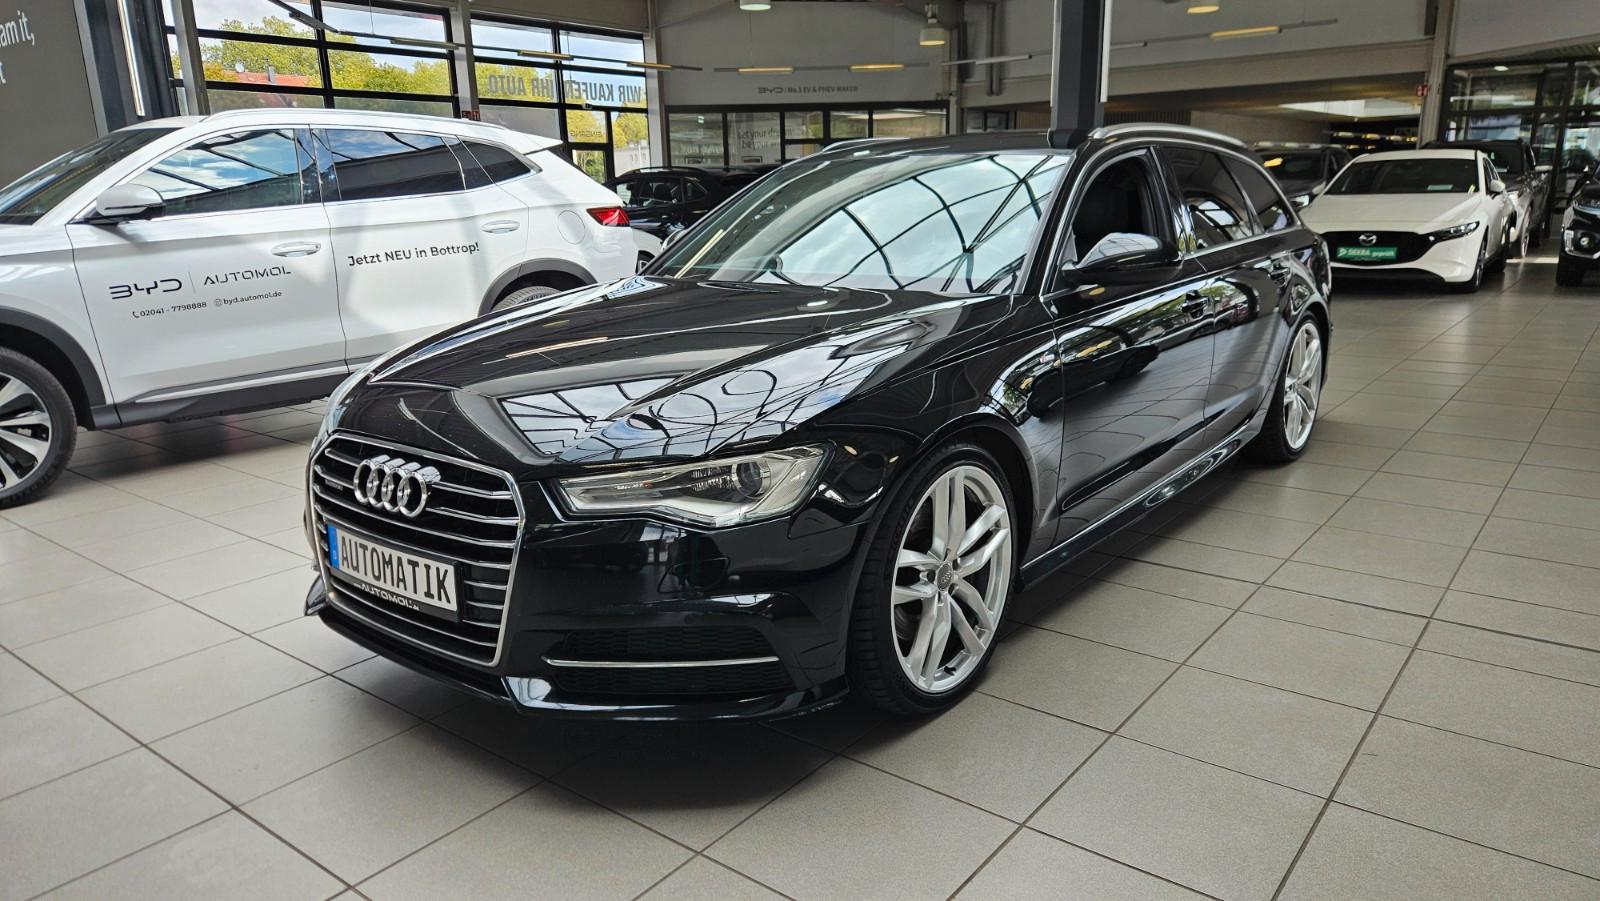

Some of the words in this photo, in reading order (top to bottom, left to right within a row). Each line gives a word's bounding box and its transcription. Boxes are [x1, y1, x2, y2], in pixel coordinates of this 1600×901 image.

[17, 9, 35, 46] it,
[347, 253, 382, 267] Jetzt
[384, 249, 412, 262] NEU
[414, 247, 428, 258] in
[429, 242, 480, 256] Bottrop!
[108, 278, 182, 300] BYD
[203, 266, 292, 286] AUTOMOL
[140, 307, 164, 317] 02041
[341, 535, 452, 604] AUTOMATIK
